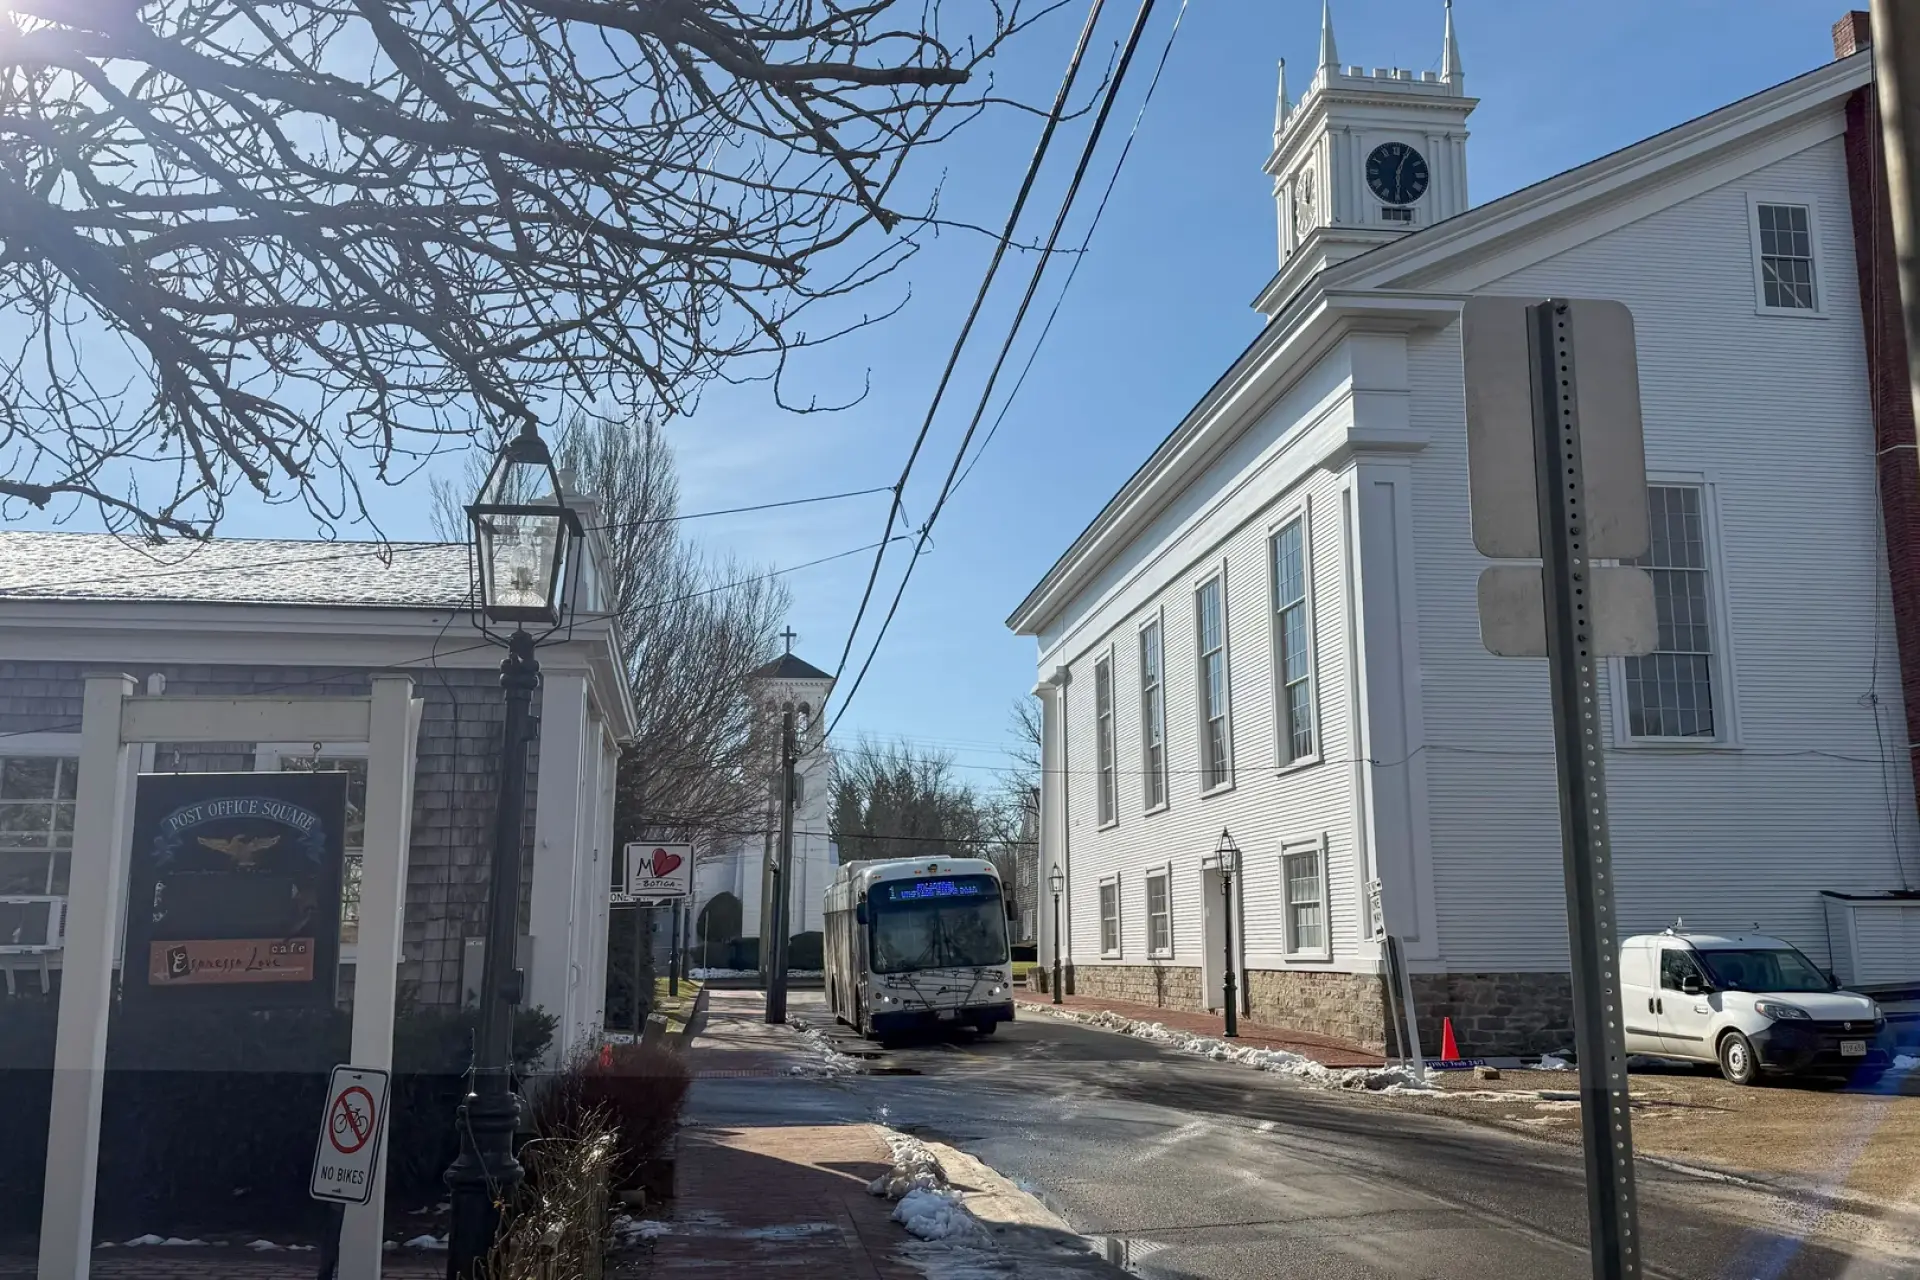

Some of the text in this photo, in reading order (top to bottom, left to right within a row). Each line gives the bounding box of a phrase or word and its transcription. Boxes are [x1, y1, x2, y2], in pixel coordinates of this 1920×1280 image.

[168, 800, 316, 832] POST OFFICE SQUARE
[889, 885, 897, 900] 1
[271, 942, 306, 954] cafe
[172, 947, 281, 973] Espresso Love
[321, 1166, 365, 1185] NO BIKES
